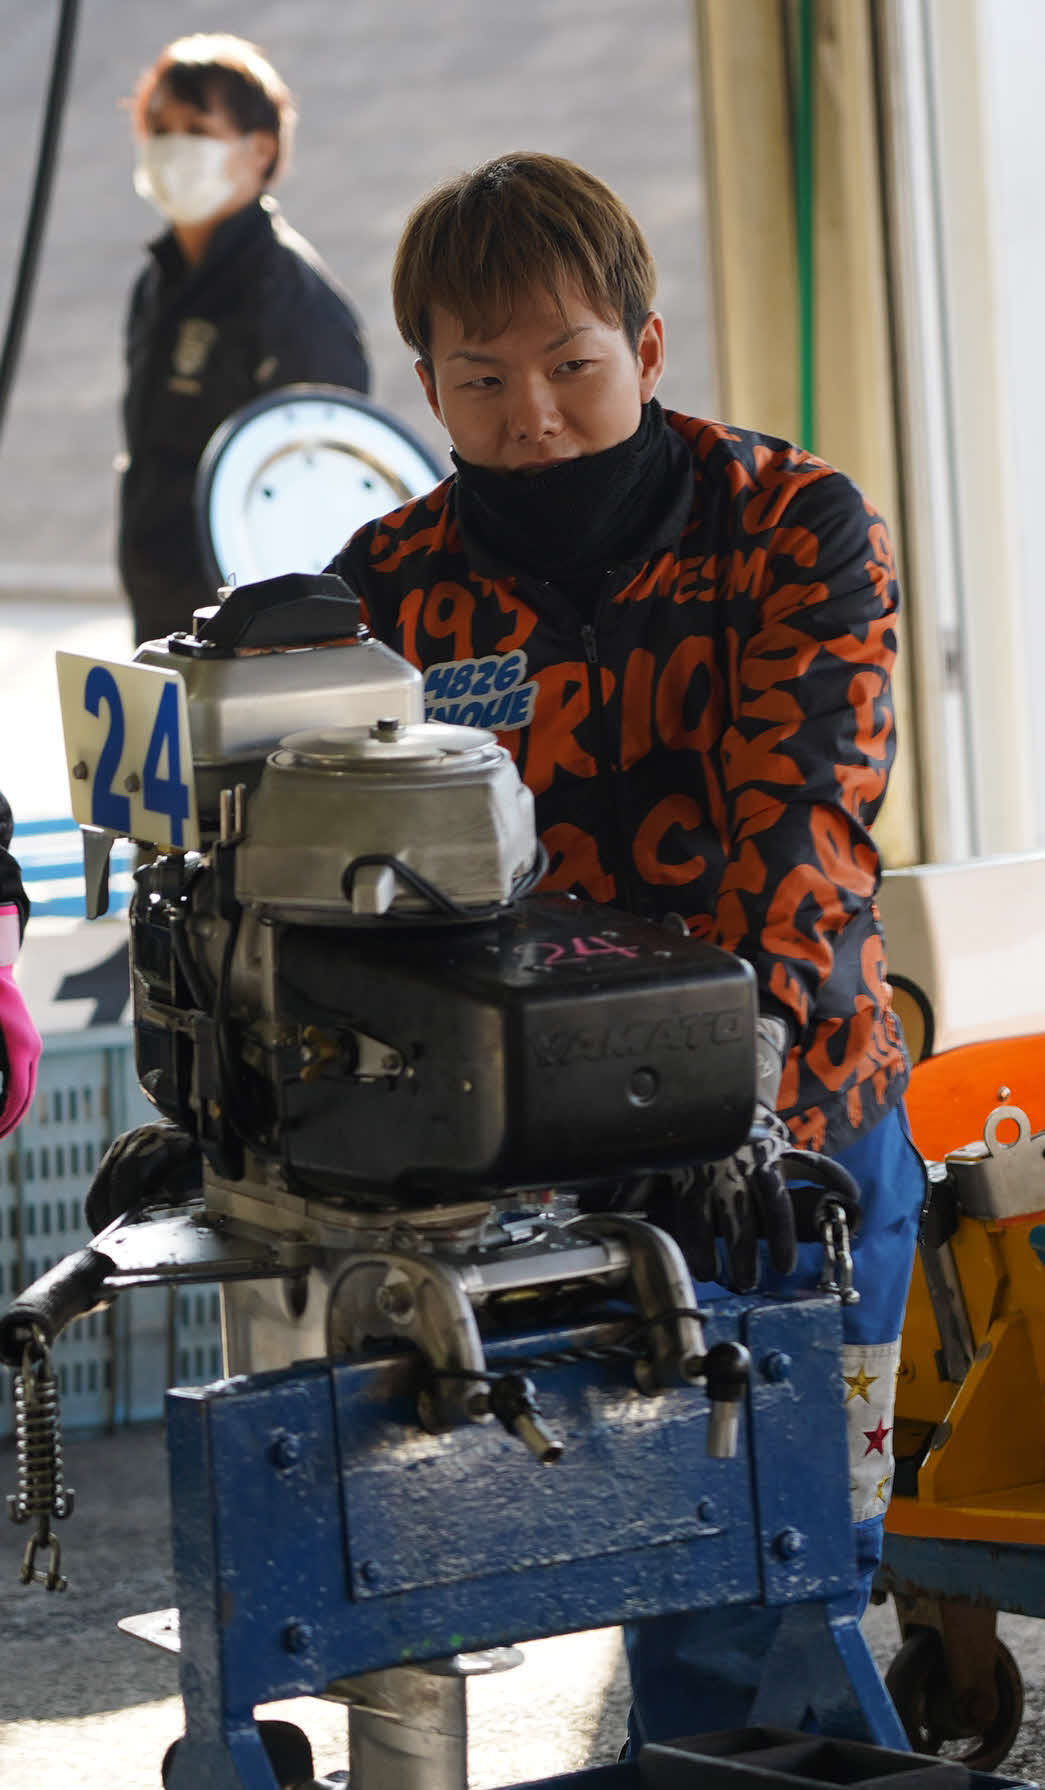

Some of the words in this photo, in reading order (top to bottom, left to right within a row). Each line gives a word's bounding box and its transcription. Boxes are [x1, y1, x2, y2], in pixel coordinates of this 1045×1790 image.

[424, 655, 520, 700] 4826
[84, 666, 190, 846] 24
[513, 935, 640, 967] 24
